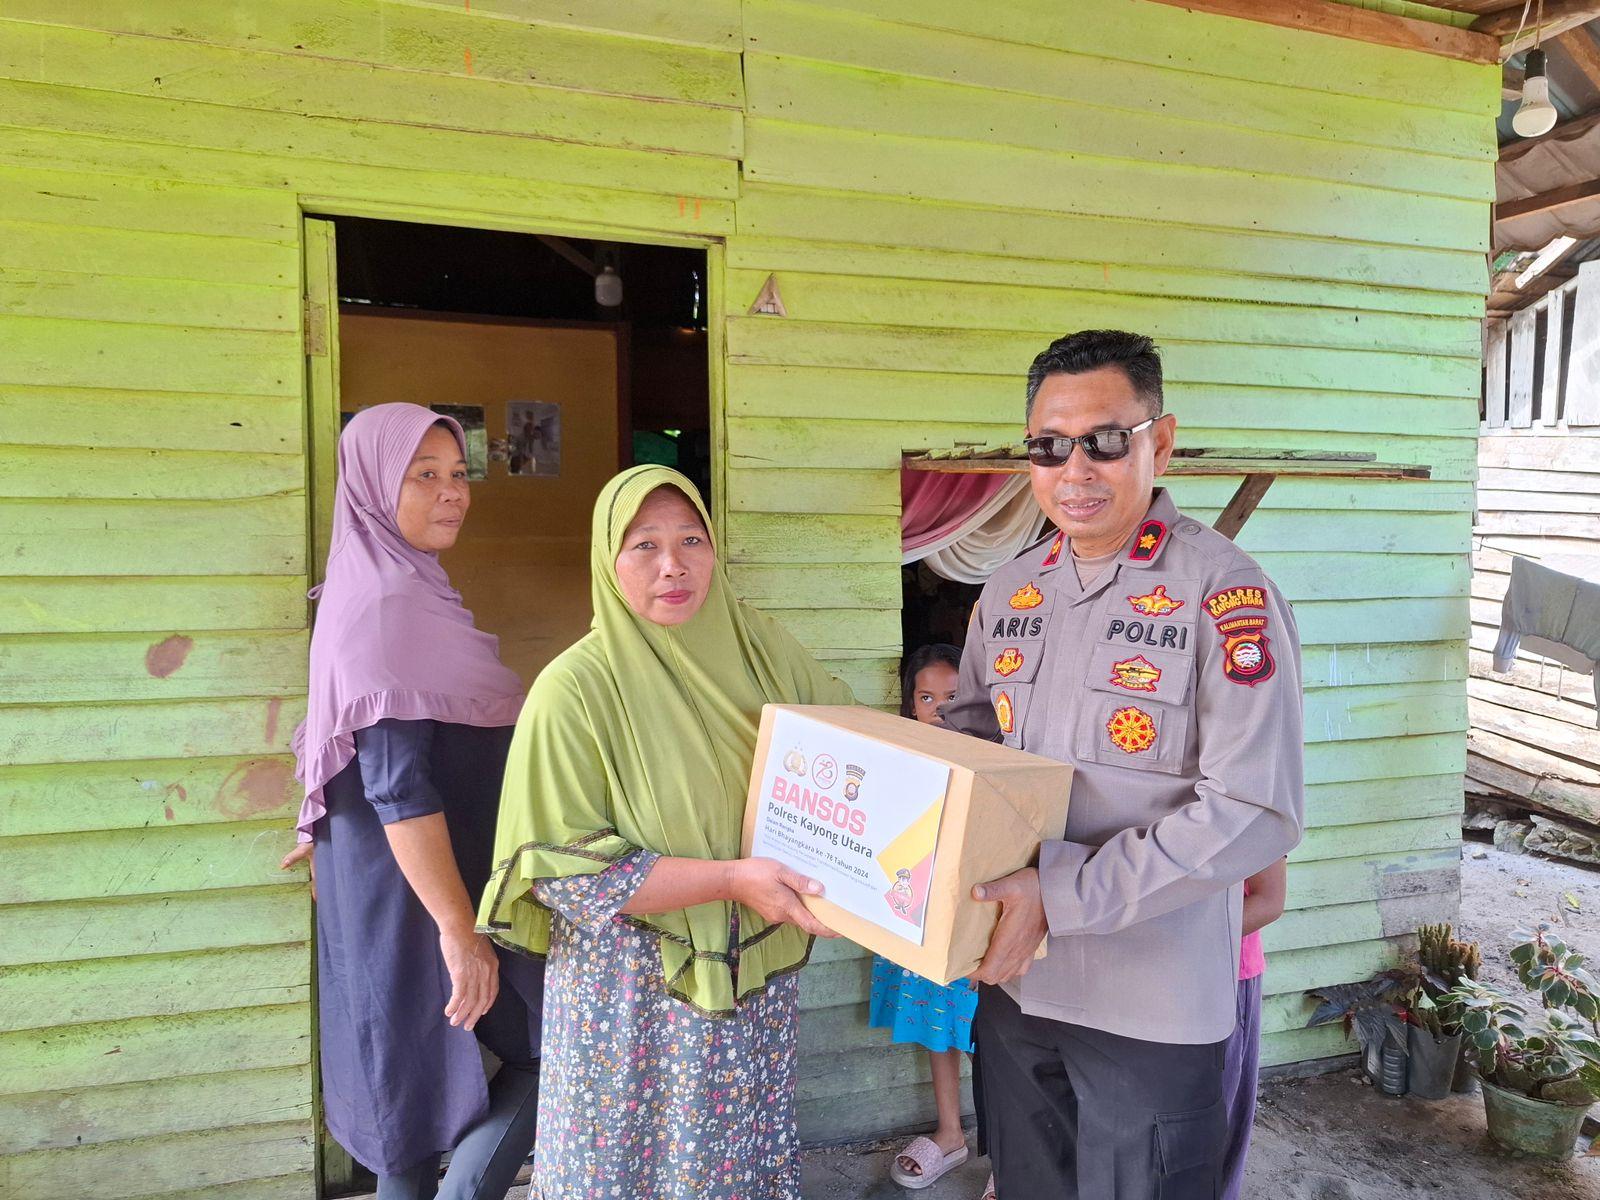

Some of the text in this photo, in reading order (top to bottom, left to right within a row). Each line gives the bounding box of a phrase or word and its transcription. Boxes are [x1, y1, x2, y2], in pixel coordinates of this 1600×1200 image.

[1209, 589, 1261, 607] POLRES
[1210, 596, 1263, 616] KAYONG UTARA
[992, 616, 1042, 638] ARIS
[1106, 620, 1188, 650] POLRI
[771, 775, 867, 836] BANSOS
[768, 802, 798, 824] Polres
[800, 816, 838, 846] Kayong
[841, 835, 873, 858] Utara
[765, 825, 777, 835] Hari
[777, 830, 815, 852] Bhayangkara
[834, 856, 853, 872] Tahun
[853, 867, 869, 879] 2024
